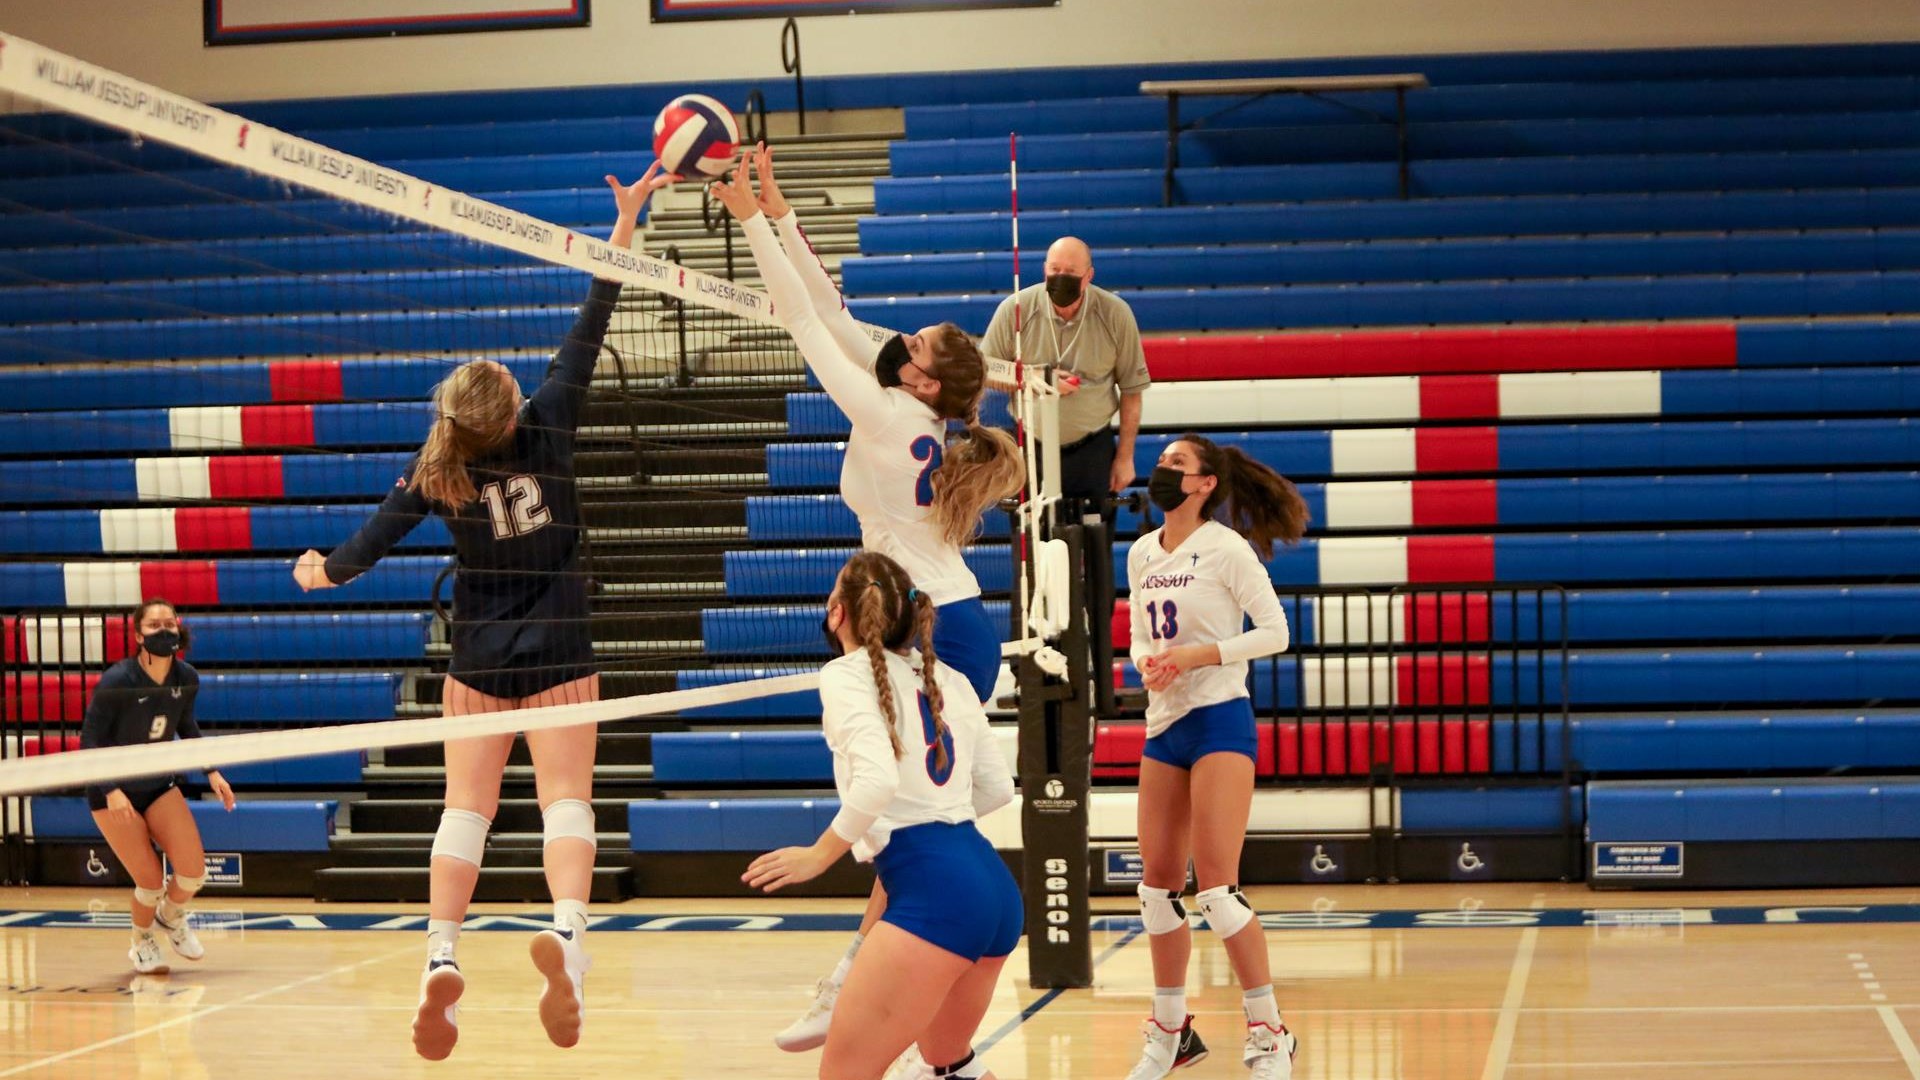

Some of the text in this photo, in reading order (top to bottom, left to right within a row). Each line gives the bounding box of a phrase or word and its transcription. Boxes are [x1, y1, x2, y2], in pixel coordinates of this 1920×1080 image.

[480, 474, 552, 540] 12
[1146, 599, 1178, 640] 13
[149, 715, 168, 739] 9
